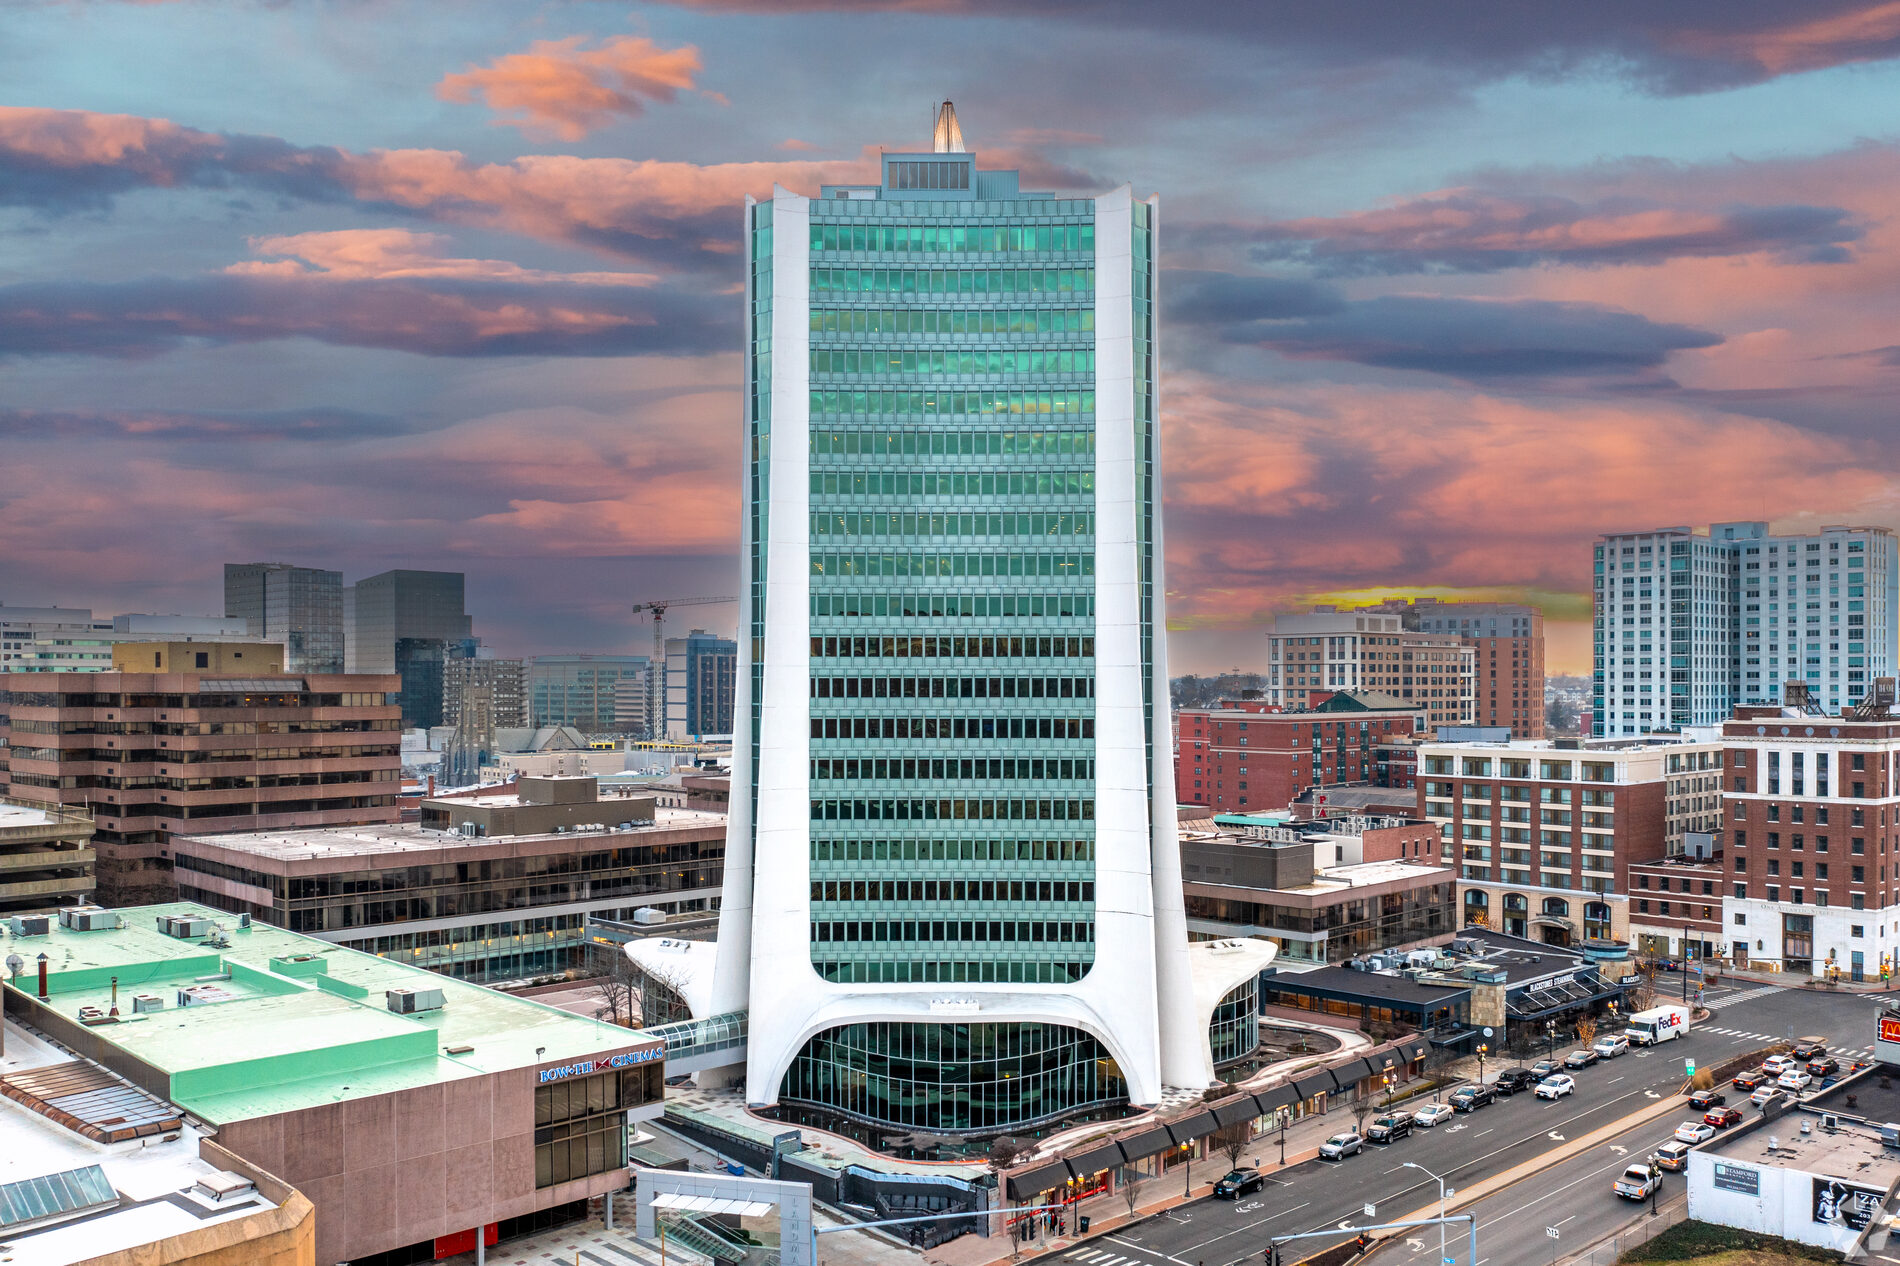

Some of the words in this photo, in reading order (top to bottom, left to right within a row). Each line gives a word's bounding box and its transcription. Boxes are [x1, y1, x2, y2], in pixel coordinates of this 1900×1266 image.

[1658, 1012, 1682, 1031] FedEx
[611, 1047, 663, 1068] CINEMAS
[1725, 1167, 1757, 1178] STAMFORD
